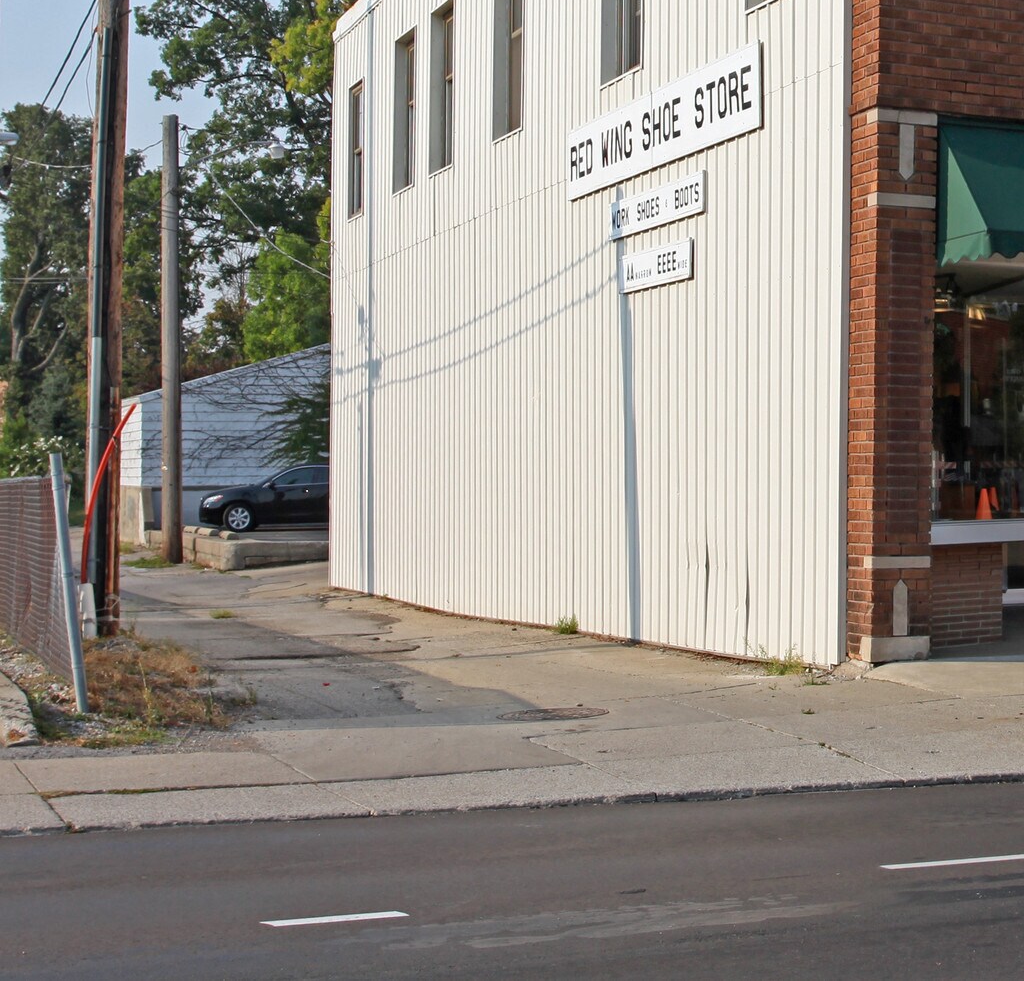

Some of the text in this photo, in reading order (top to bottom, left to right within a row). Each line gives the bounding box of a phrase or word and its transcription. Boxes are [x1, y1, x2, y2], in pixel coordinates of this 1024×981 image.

[570, 64, 752, 182] RED WING SHOE STORE
[612, 206, 630, 232] WORK
[637, 196, 660, 222] SHOES
[674, 182, 700, 210] BOOTS
[626, 262, 634, 282] AA
[657, 251, 677, 275] EEEE
